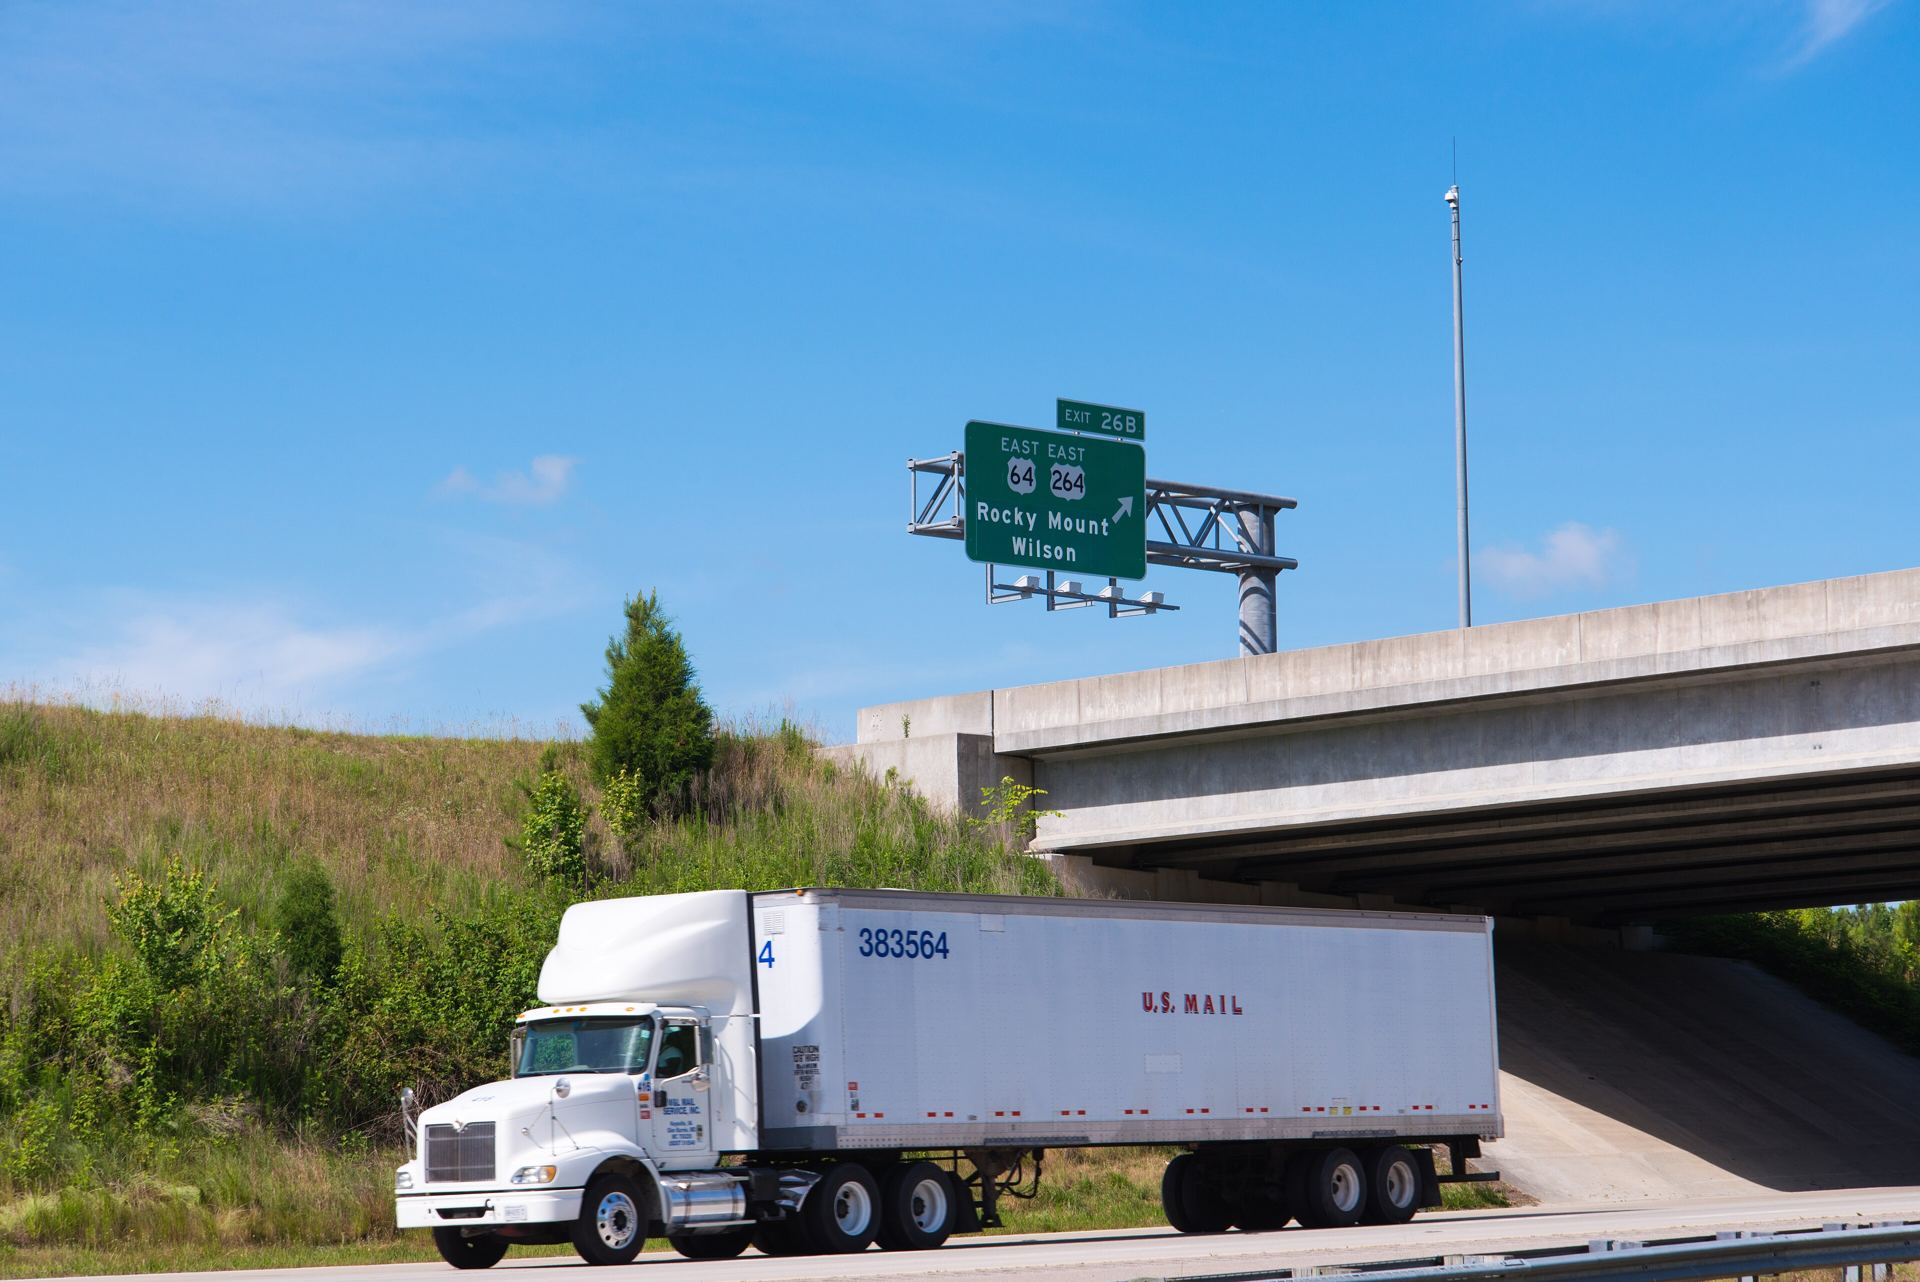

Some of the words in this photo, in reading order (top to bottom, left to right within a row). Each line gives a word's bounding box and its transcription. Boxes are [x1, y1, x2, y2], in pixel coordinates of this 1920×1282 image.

[1065, 409, 1091, 424] EXIT
[1101, 412, 1136, 433] 26B
[1001, 437, 1039, 455] EAST
[1048, 444, 1085, 462] EAST
[1010, 465, 1034, 487] 64
[1052, 469, 1084, 493] 264
[977, 501, 1037, 531] Rocky
[1049, 511, 1109, 536] Mount
[1012, 536, 1076, 562] Wilson
[859, 928, 950, 959] 383564
[1142, 991, 1176, 1014] U.S.
[1184, 993, 1243, 1016] MAIL
